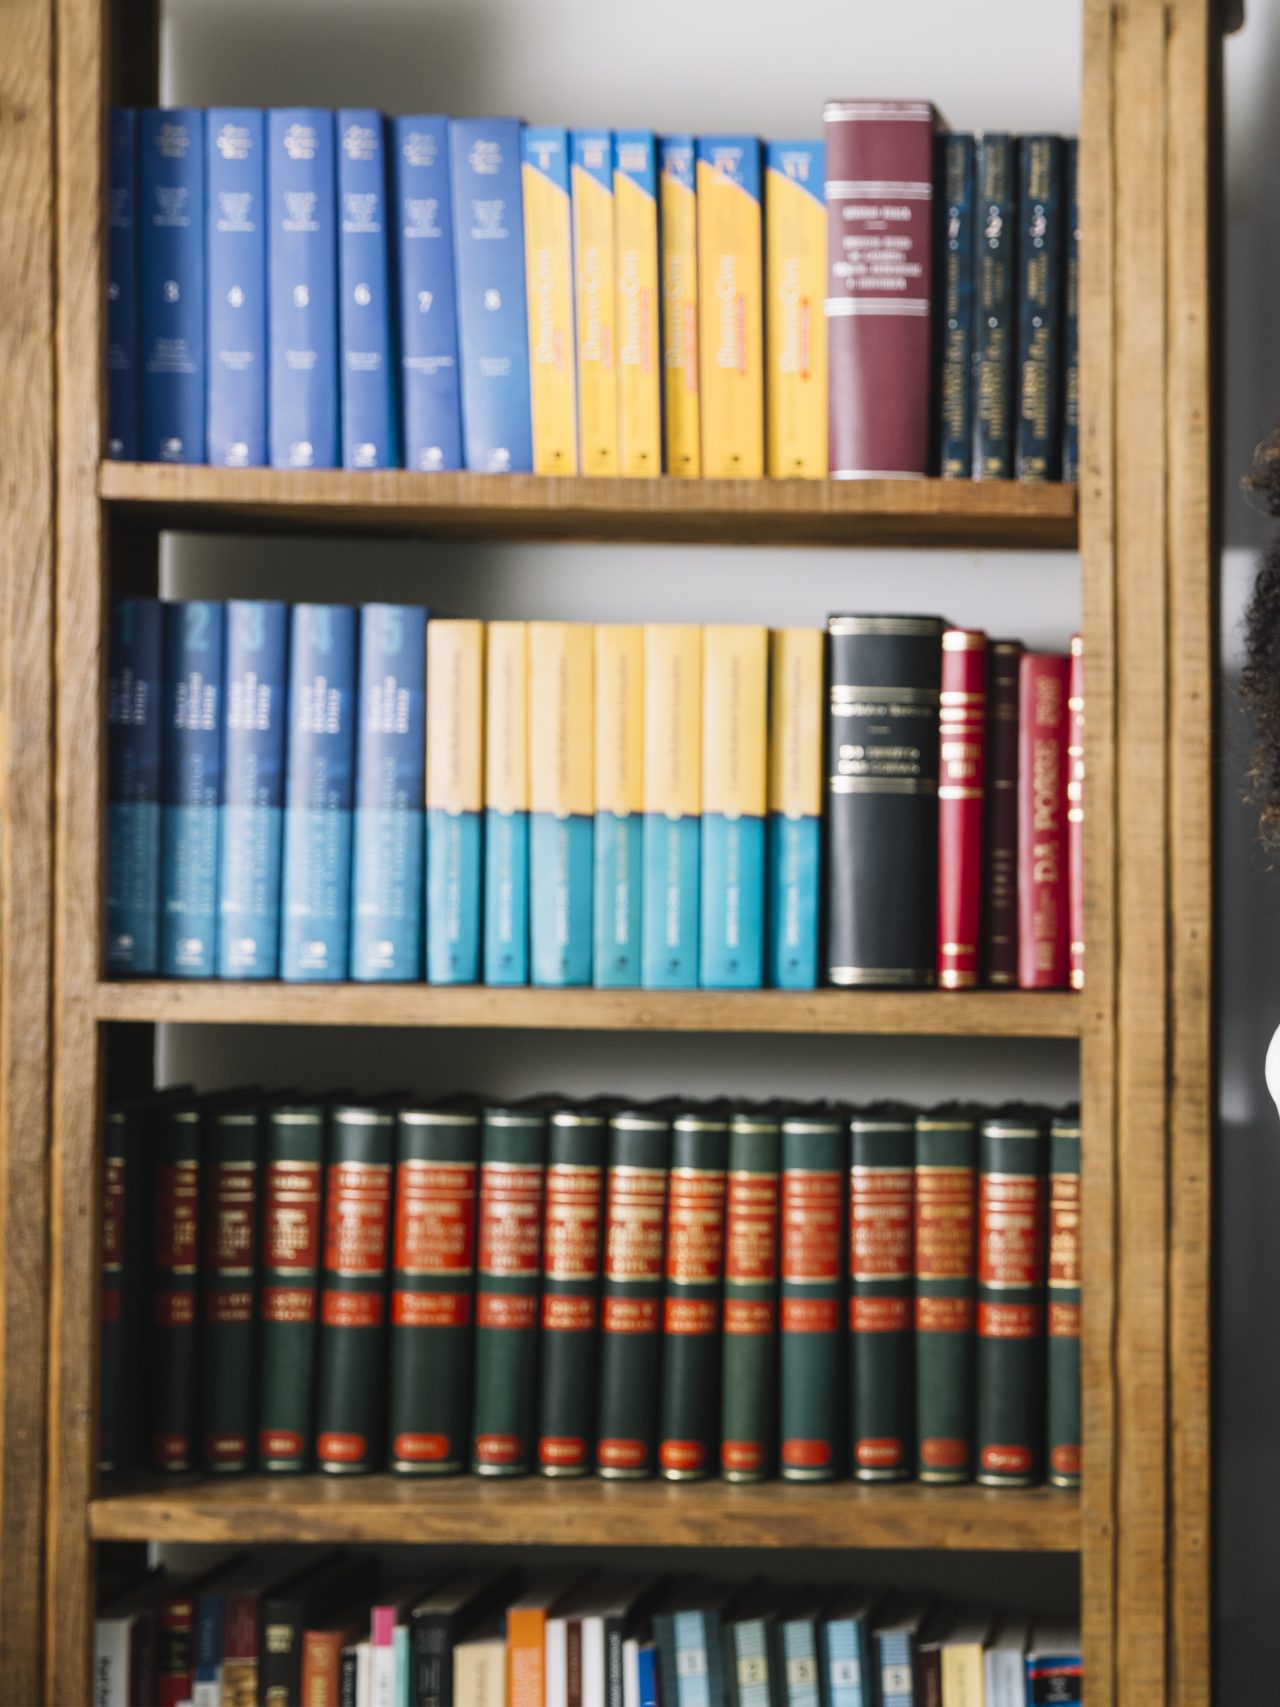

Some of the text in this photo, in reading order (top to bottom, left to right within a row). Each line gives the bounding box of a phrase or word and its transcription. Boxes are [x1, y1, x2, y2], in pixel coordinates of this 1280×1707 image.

[184, 602, 209, 651] 2
[240, 602, 265, 652] 3
[307, 603, 332, 652] 4
[380, 604, 403, 653] 5
[1033, 840, 1060, 884] DA
